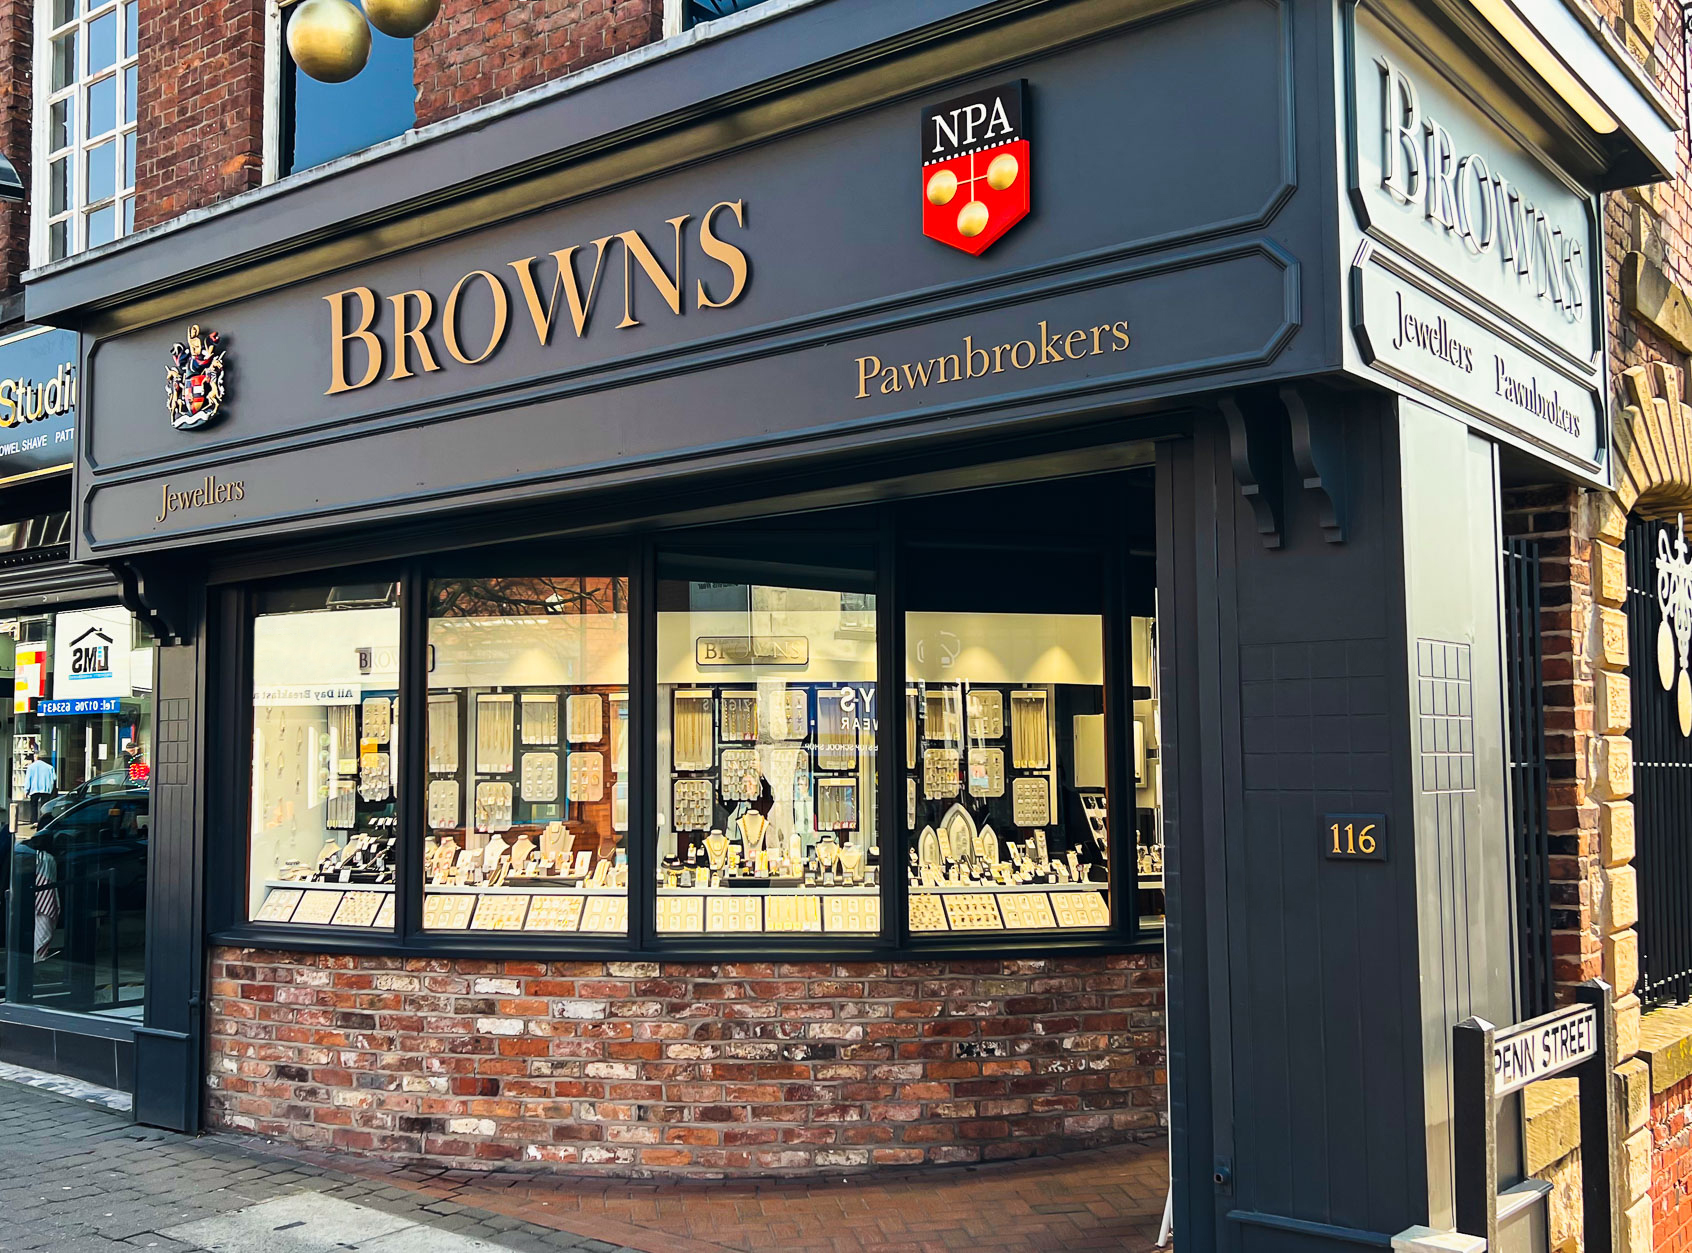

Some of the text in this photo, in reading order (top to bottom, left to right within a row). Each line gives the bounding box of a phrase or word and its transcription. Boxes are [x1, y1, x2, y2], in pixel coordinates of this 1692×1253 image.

[931, 96, 1014, 154] NPA
[1373, 55, 1585, 323] BROWNS
[322, 198, 749, 396] BROWNS
[854, 319, 1131, 400] Pawnbrokers
[1393, 290, 1581, 438] Jewellers Pawnbrokers
[22, 435, 48, 451] SHAVE
[156, 475, 245, 523] Jewellers
[1330, 823, 1376, 854] 116
[1494, 1014, 1593, 1085] PENN STREET
